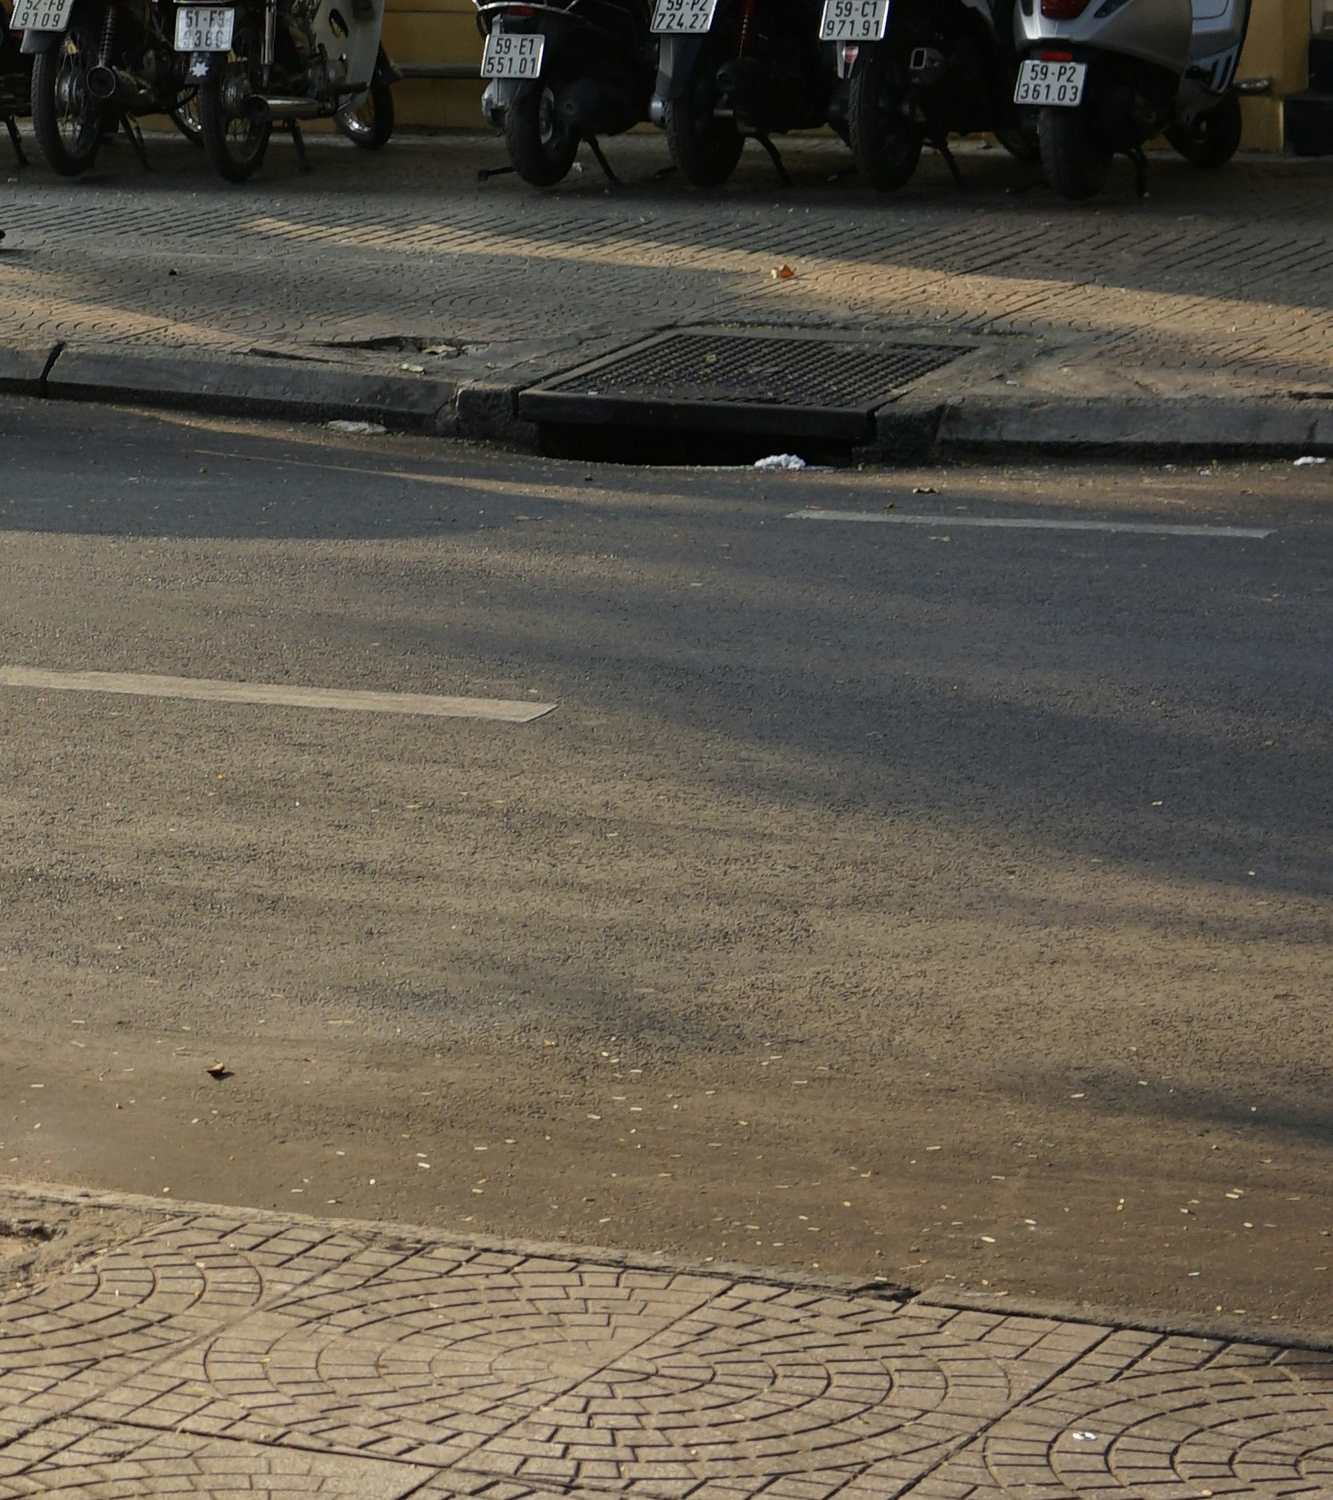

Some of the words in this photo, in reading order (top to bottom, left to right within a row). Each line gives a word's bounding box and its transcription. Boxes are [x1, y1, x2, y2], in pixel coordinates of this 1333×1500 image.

[835, 1, 878, 18] 59-C1
[20, 12, 61, 27] 9109
[656, 13, 709, 29] 724.27
[826, 20, 880, 37] 971.91
[495, 38, 535, 55] 59-E1
[486, 57, 536, 74] 551.01
[1030, 64, 1077, 83] 59-P2
[1020, 83, 1079, 102] 361.03
